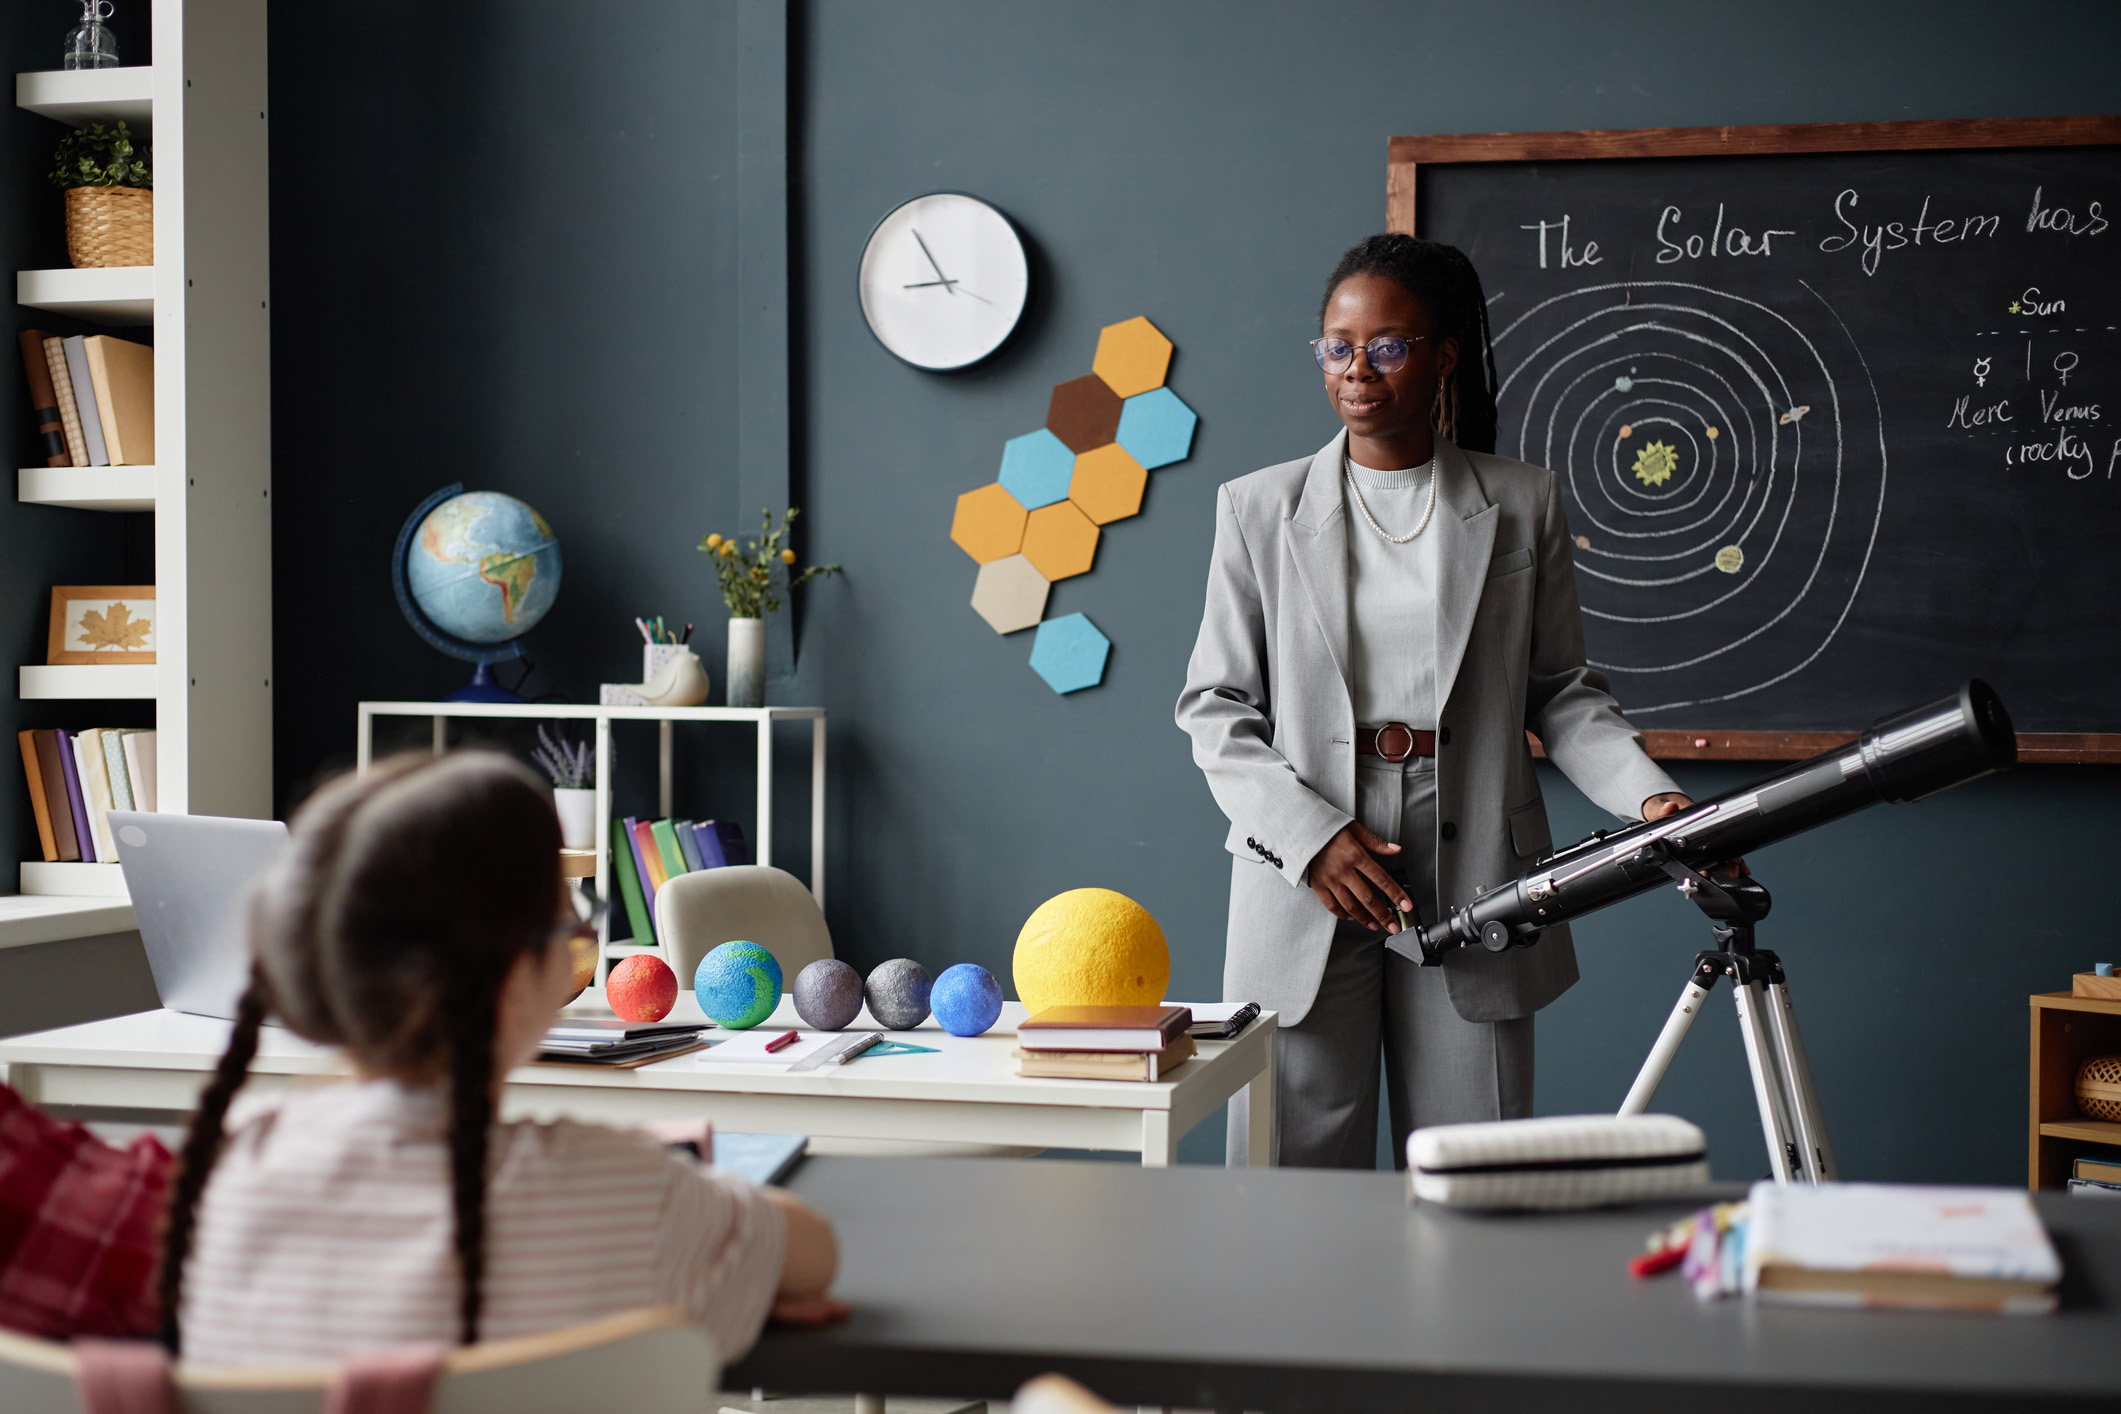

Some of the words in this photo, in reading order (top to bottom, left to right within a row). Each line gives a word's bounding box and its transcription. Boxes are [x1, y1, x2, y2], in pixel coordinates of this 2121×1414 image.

[1520, 214, 1603, 268] The
[1655, 203, 1796, 264] Solar
[1819, 188, 2000, 277] System
[2026, 185, 2109, 236] has
[2022, 286, 2066, 316] Sun
[1946, 394, 2014, 430] Merc
[2041, 388, 2102, 424] Venus
